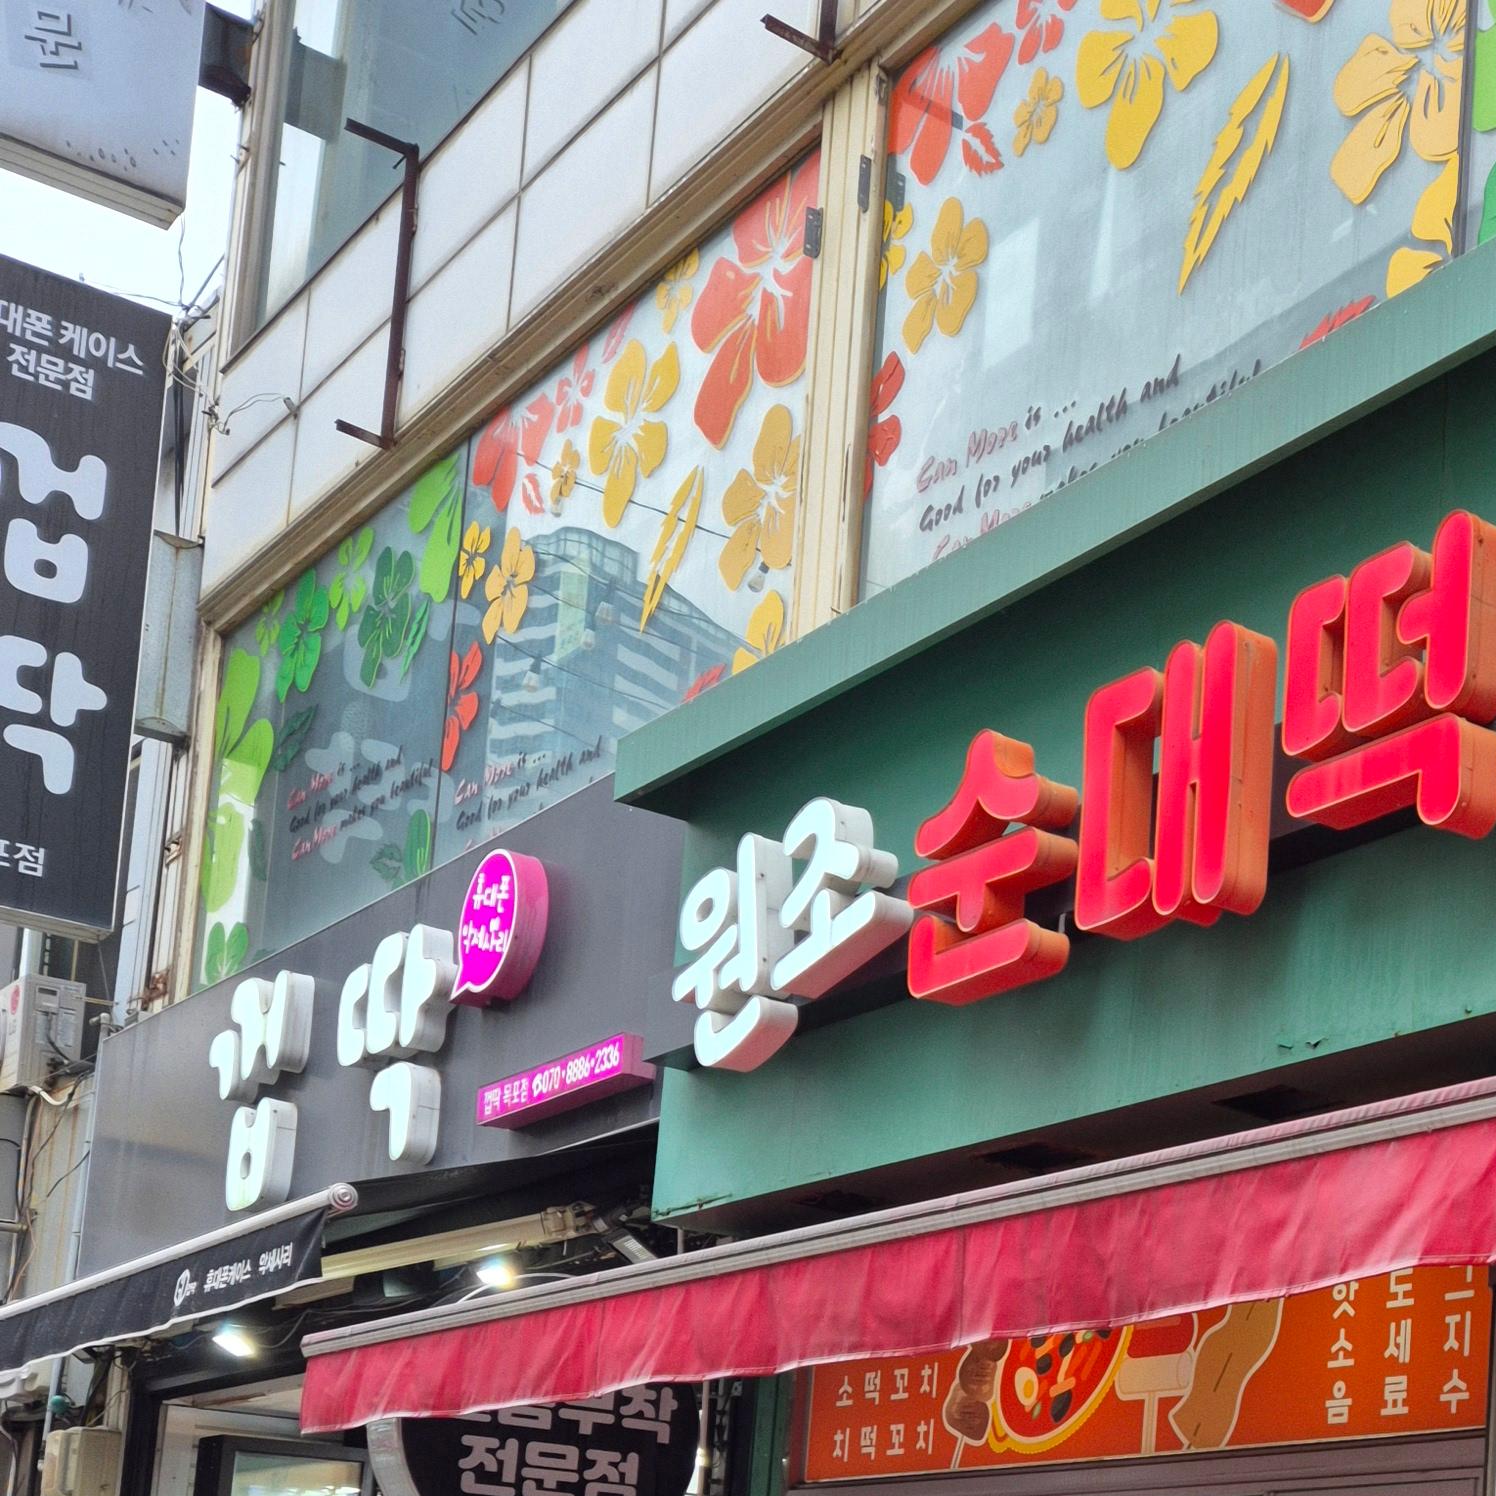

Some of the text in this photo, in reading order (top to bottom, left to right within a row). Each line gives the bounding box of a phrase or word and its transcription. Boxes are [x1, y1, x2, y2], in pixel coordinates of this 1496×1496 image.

[7, 342, 95, 401] 전문점
[58, 320, 145, 376] 케이스
[919, 485, 964, 532] Good
[975, 474, 1000, 509] for
[1011, 444, 1051, 488] your
[1062, 387, 1128, 452] health
[1141, 354, 1181, 403] and
[456, 801, 482, 831] Good
[536, 751, 573, 790] health
[579, 735, 602, 765] and
[473, 873, 511, 913] 휴대폰
[462, 920, 509, 954] 악세사리
[672, 797, 912, 1071] 원조
[203, 1258, 252, 1294] 휴대폰케이스
[258, 1241, 293, 1276] 악세사리
[1327, 1310, 1471, 1369] 소세지
[835, 1361, 938, 1407] 소떡꼬치
[1325, 1368, 1470, 1425] 음료수
[832, 1418, 934, 1462] 치떡꼬치
